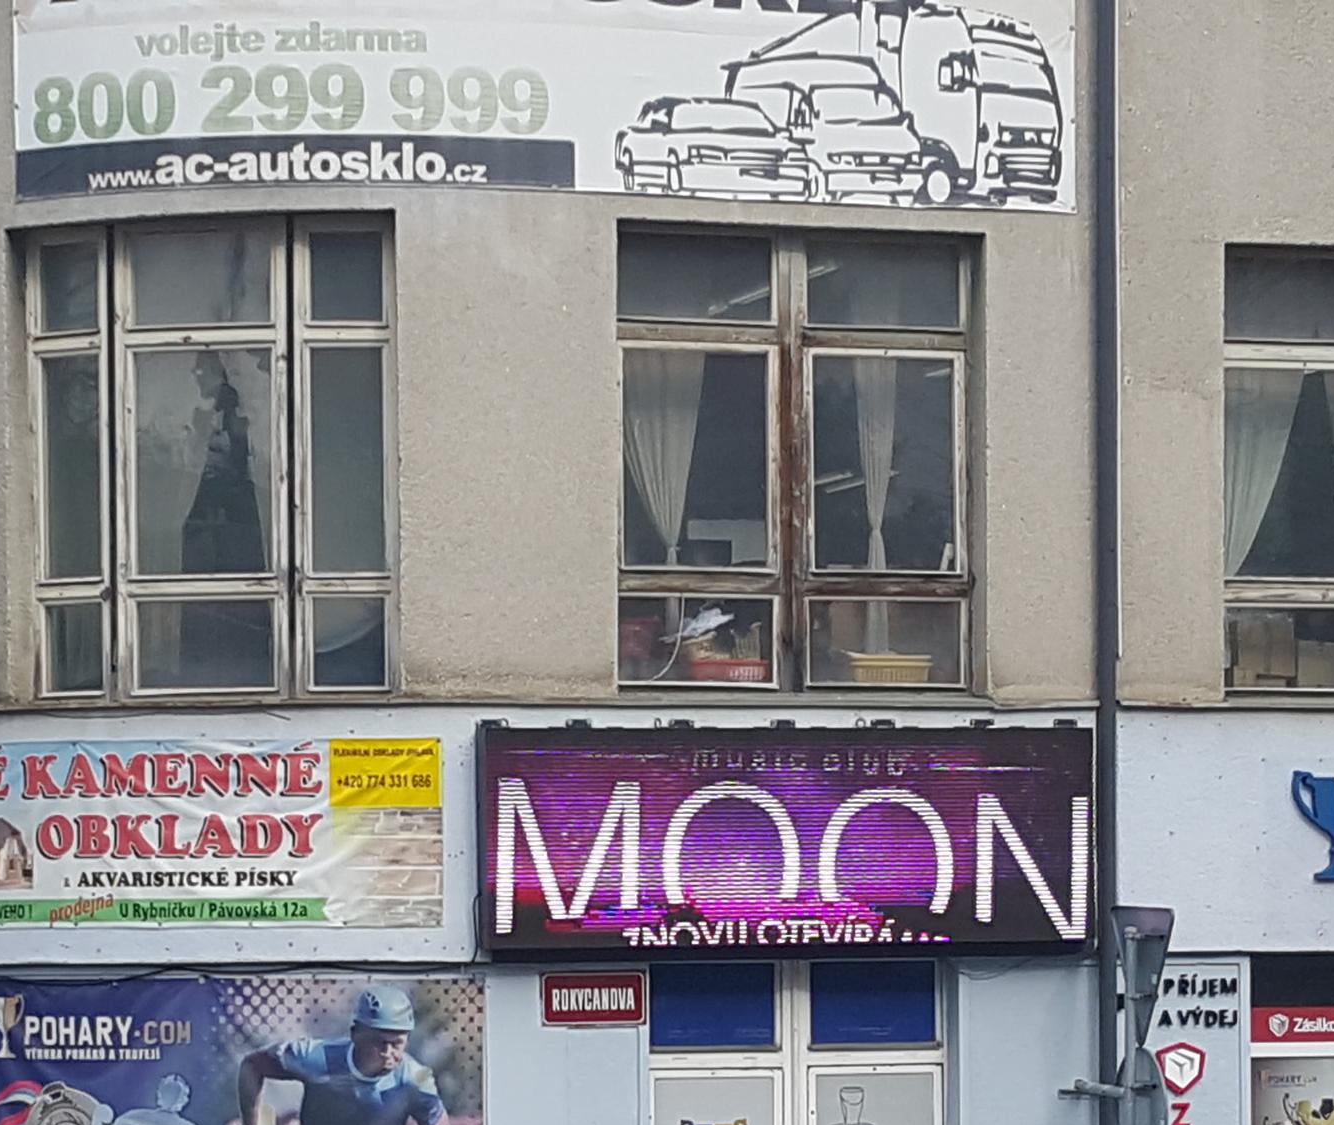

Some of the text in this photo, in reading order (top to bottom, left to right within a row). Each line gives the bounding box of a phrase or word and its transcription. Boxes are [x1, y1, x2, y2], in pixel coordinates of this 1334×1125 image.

[136, 22, 427, 62] volejte zdarma
[34, 63, 549, 144] 800 299 999
[88, 136, 487, 188] www.ac-autosklo.cz
[22, 741, 324, 800] KAMENNÉ
[367, 774, 386, 788] 774
[388, 774, 408, 788] 331
[36, 813, 325, 861] OBKLADY
[495, 777, 1090, 940] MOON
[77, 867, 298, 888] AKVARISTICKÉ PÍSKY
[49, 892, 114, 926] prodejna
[119, 903, 130, 918] U
[210, 901, 278, 919] Pávovská
[282, 902, 308, 918] 12a
[551, 986, 636, 1012] ROKYCANOVA
[1163, 973, 1238, 997] PŘÍJEM
[1158, 1005, 1238, 1028] A VÝDEJ
